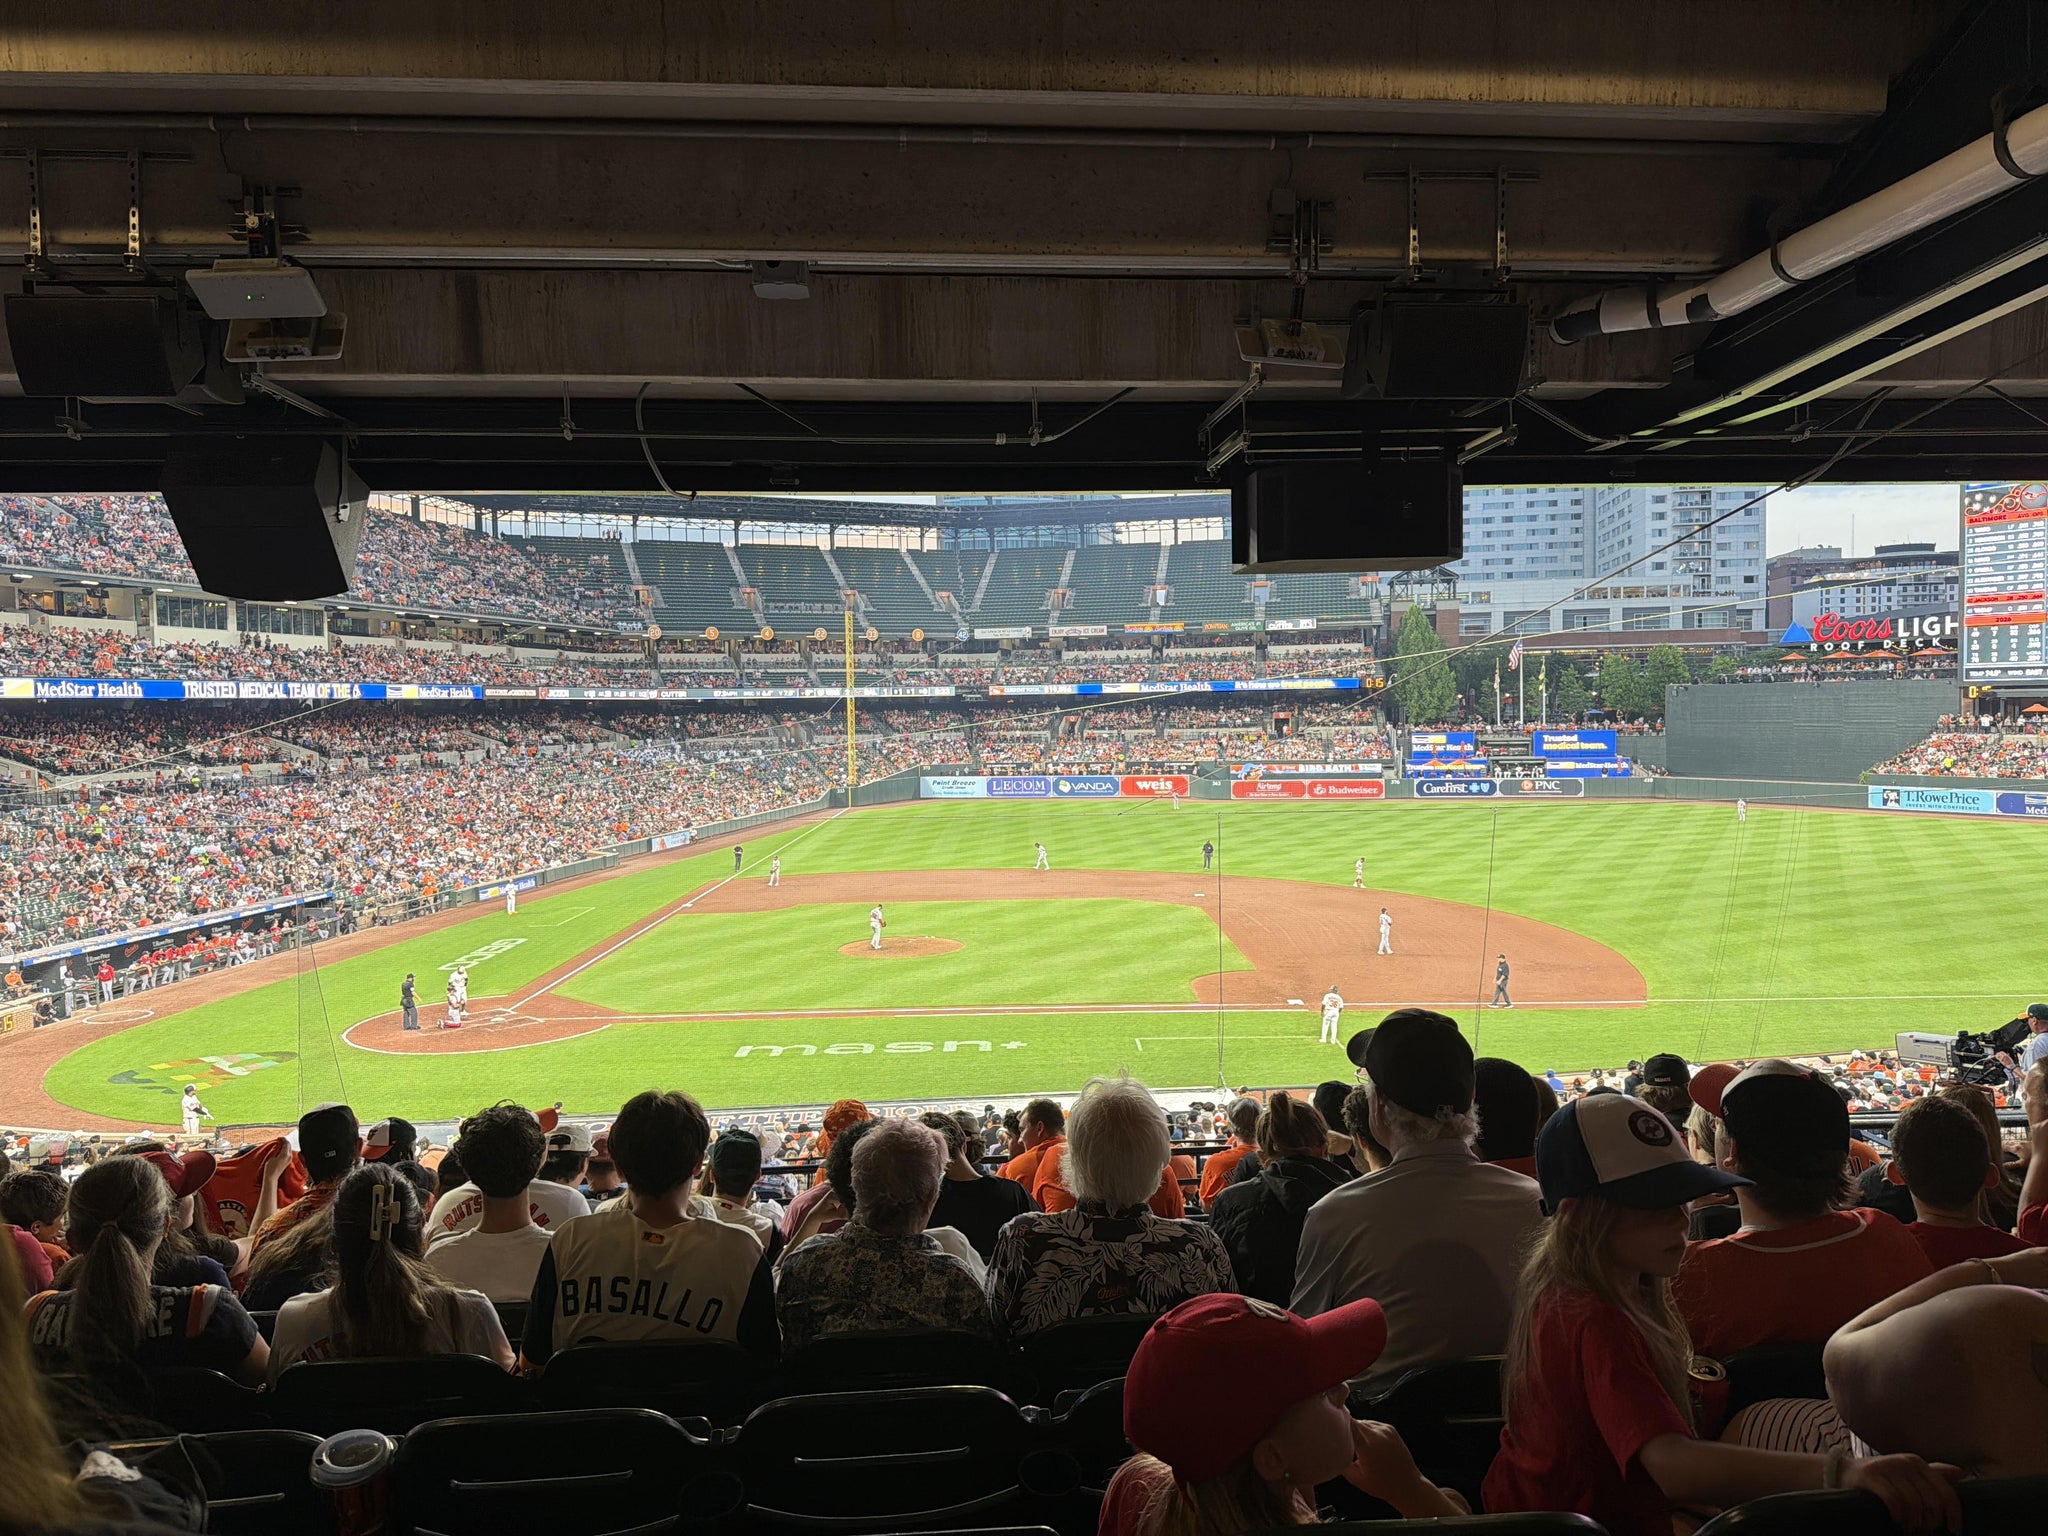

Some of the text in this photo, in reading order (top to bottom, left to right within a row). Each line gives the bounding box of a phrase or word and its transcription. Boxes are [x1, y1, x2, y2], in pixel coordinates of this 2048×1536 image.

[1969, 514, 2007, 523] BALTIMORE
[1812, 611, 1959, 642] Coors LIGH
[709, 629, 715, 637] 5
[764, 630, 770, 638] 4
[958, 631, 968, 639] 42
[1810, 637, 1942, 652] ROOF DECK
[1140, 682, 1213, 692] MedStar Health
[1366, 677, 1384, 688] 0:15
[36, 681, 143, 697] MedStar Health
[182, 681, 237, 698] TRUSTED
[239, 682, 286, 698] MEDICAL
[287, 683, 315, 698] TEAM
[317, 683, 331, 698] OF
[332, 683, 350, 698] THE
[419, 685, 449, 697] MedStar
[450, 686, 473, 697] Health
[1542, 734, 1579, 742] Trusted
[1543, 742, 1608, 750] medical team.
[992, 780, 1046, 791] LECOM
[1071, 782, 1114, 791] VANDA
[1136, 777, 1173, 791] weis
[1422, 782, 1468, 794] CareFirst
[1535, 781, 1561, 790] PNC
[1328, 785, 1379, 795] Budweiser
[741, 1107, 823, 1127] THE
[561, 1275, 724, 1334] BASALLO
